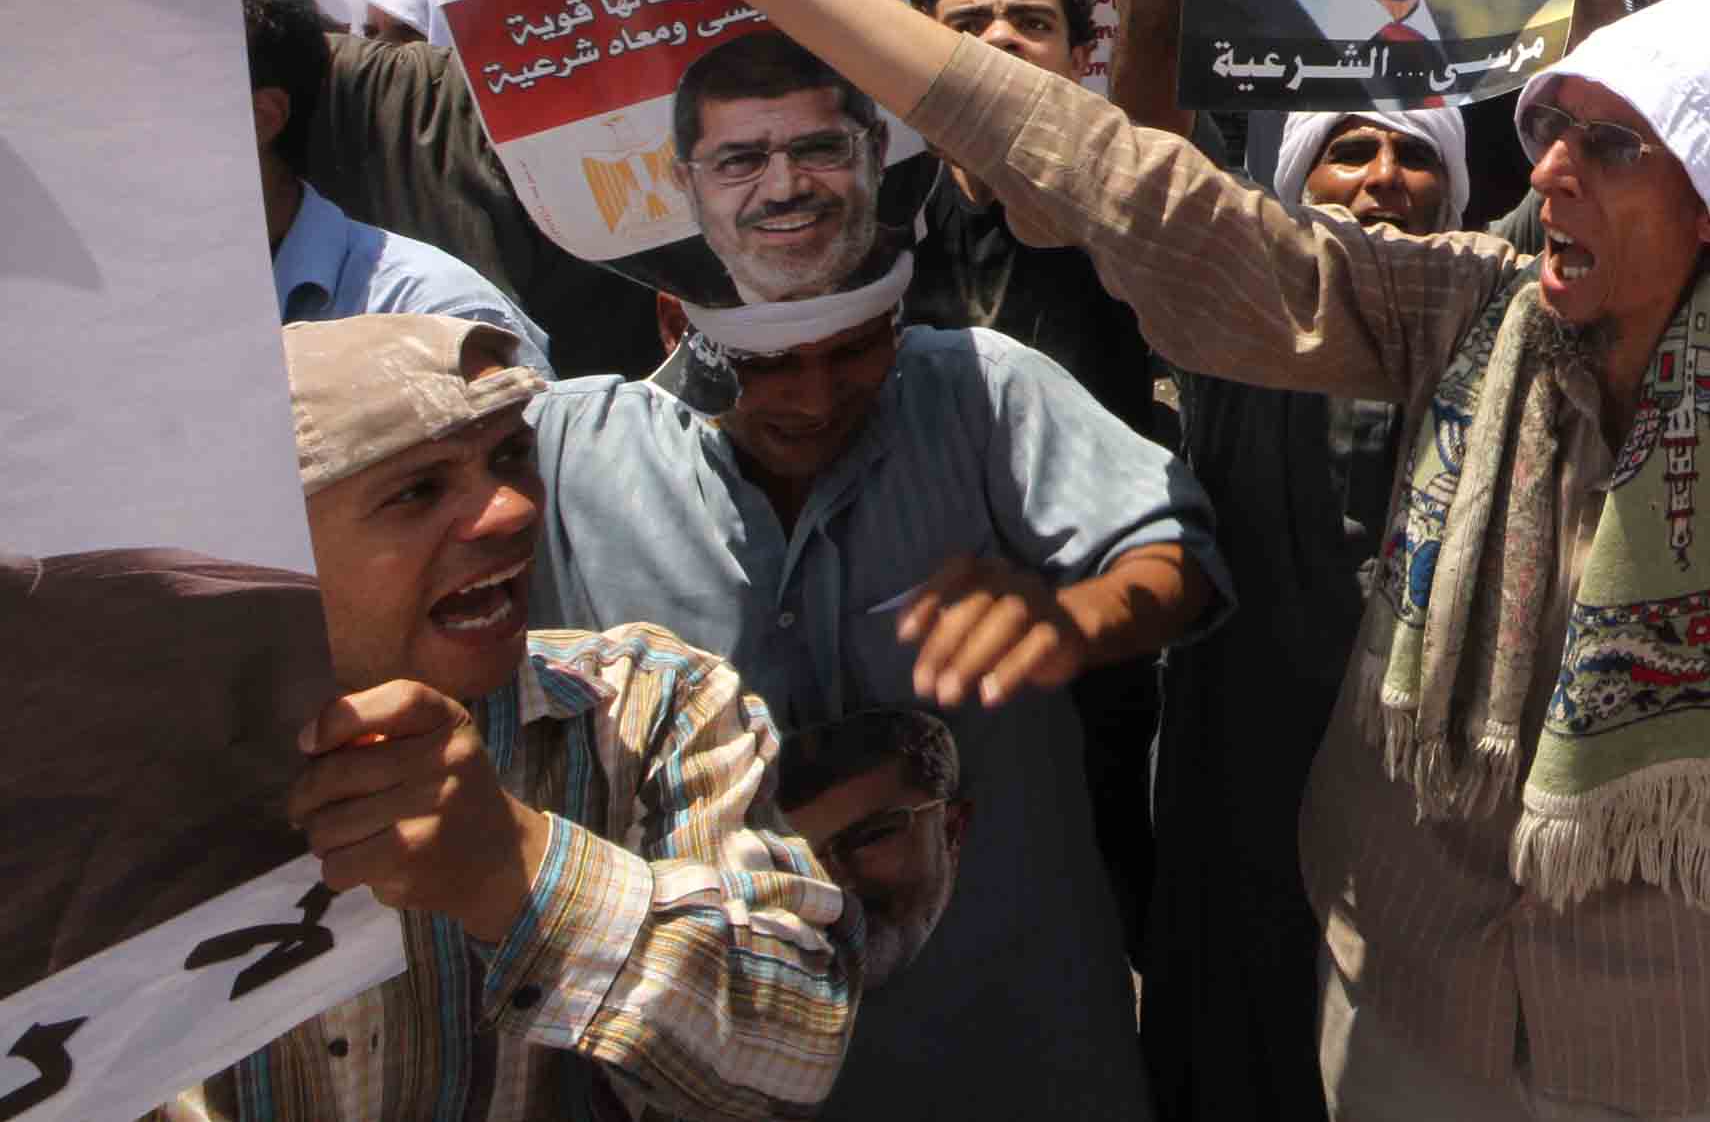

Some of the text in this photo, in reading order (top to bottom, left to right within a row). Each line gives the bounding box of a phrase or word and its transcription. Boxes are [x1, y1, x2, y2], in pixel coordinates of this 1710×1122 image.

[482, 37, 600, 95] شرعية
[608, 20, 688, 56] ومعاه
[1210, 37, 1391, 93] الشرعية
